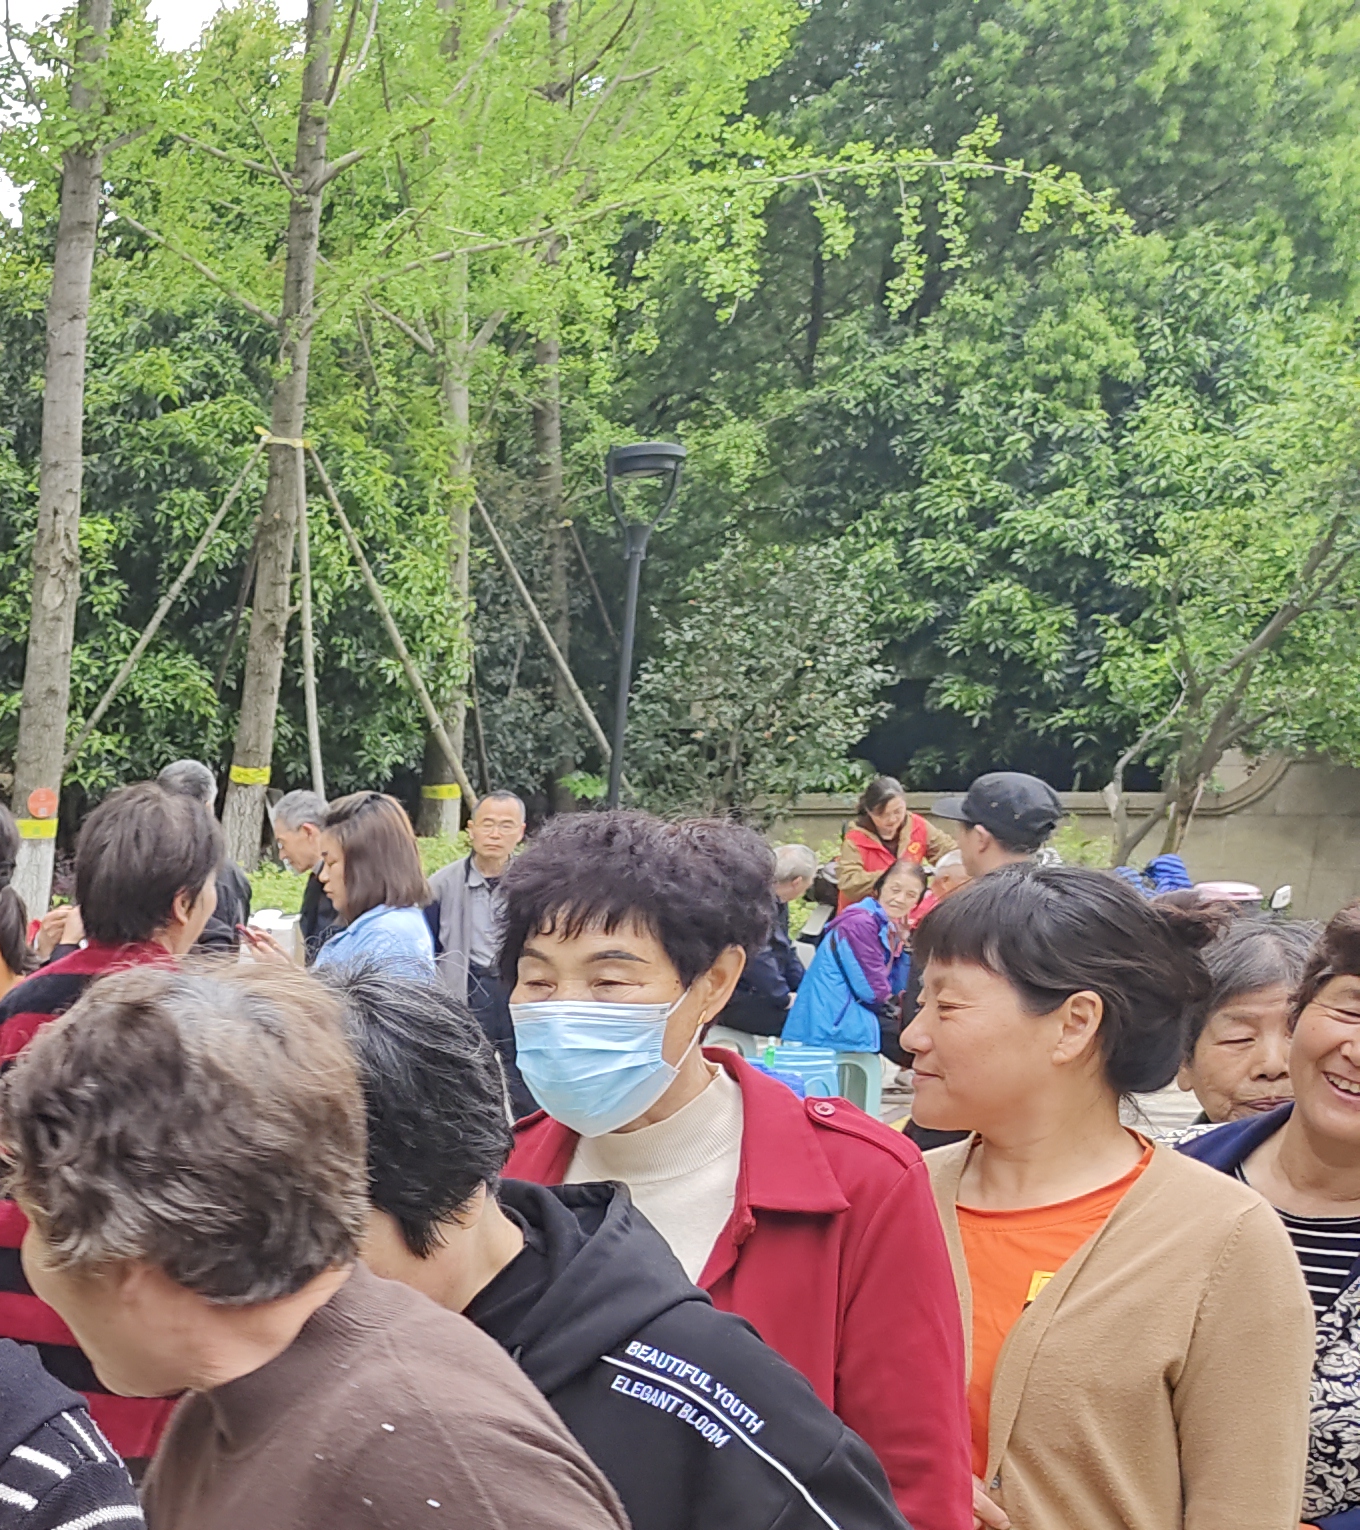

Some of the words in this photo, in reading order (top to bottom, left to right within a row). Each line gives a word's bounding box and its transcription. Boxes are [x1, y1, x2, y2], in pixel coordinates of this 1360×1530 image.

[611, 1375, 683, 1413] ELEGANT
[677, 1403, 731, 1448] BLOOM
[625, 1341, 713, 1392] BEAUTIFUL
[713, 1383, 765, 1434] YOUTH
